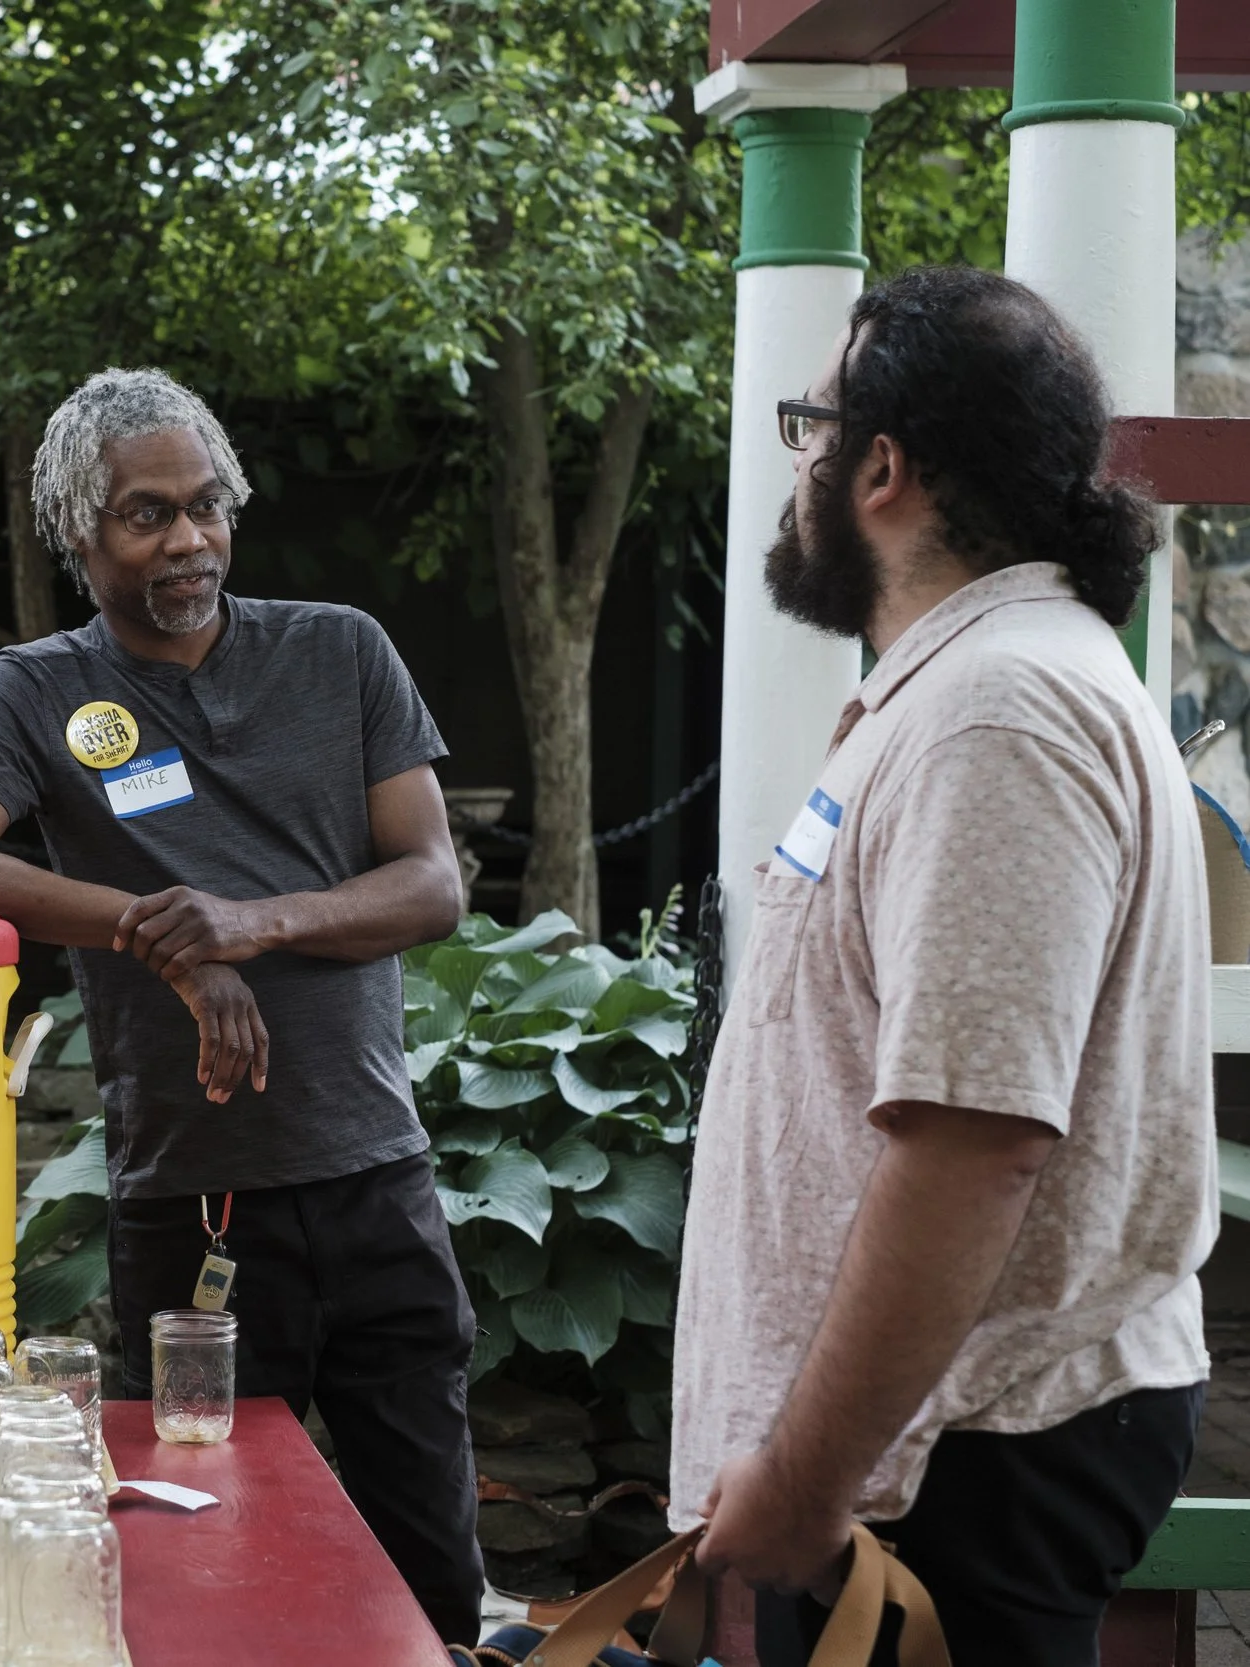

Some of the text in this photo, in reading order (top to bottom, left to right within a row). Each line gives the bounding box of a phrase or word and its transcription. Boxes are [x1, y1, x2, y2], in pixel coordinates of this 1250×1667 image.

[82, 722, 130, 755] DYER
[93, 754, 105, 763] FOR
[129, 759, 152, 771] Hello
[121, 769, 169, 796] MIKE
